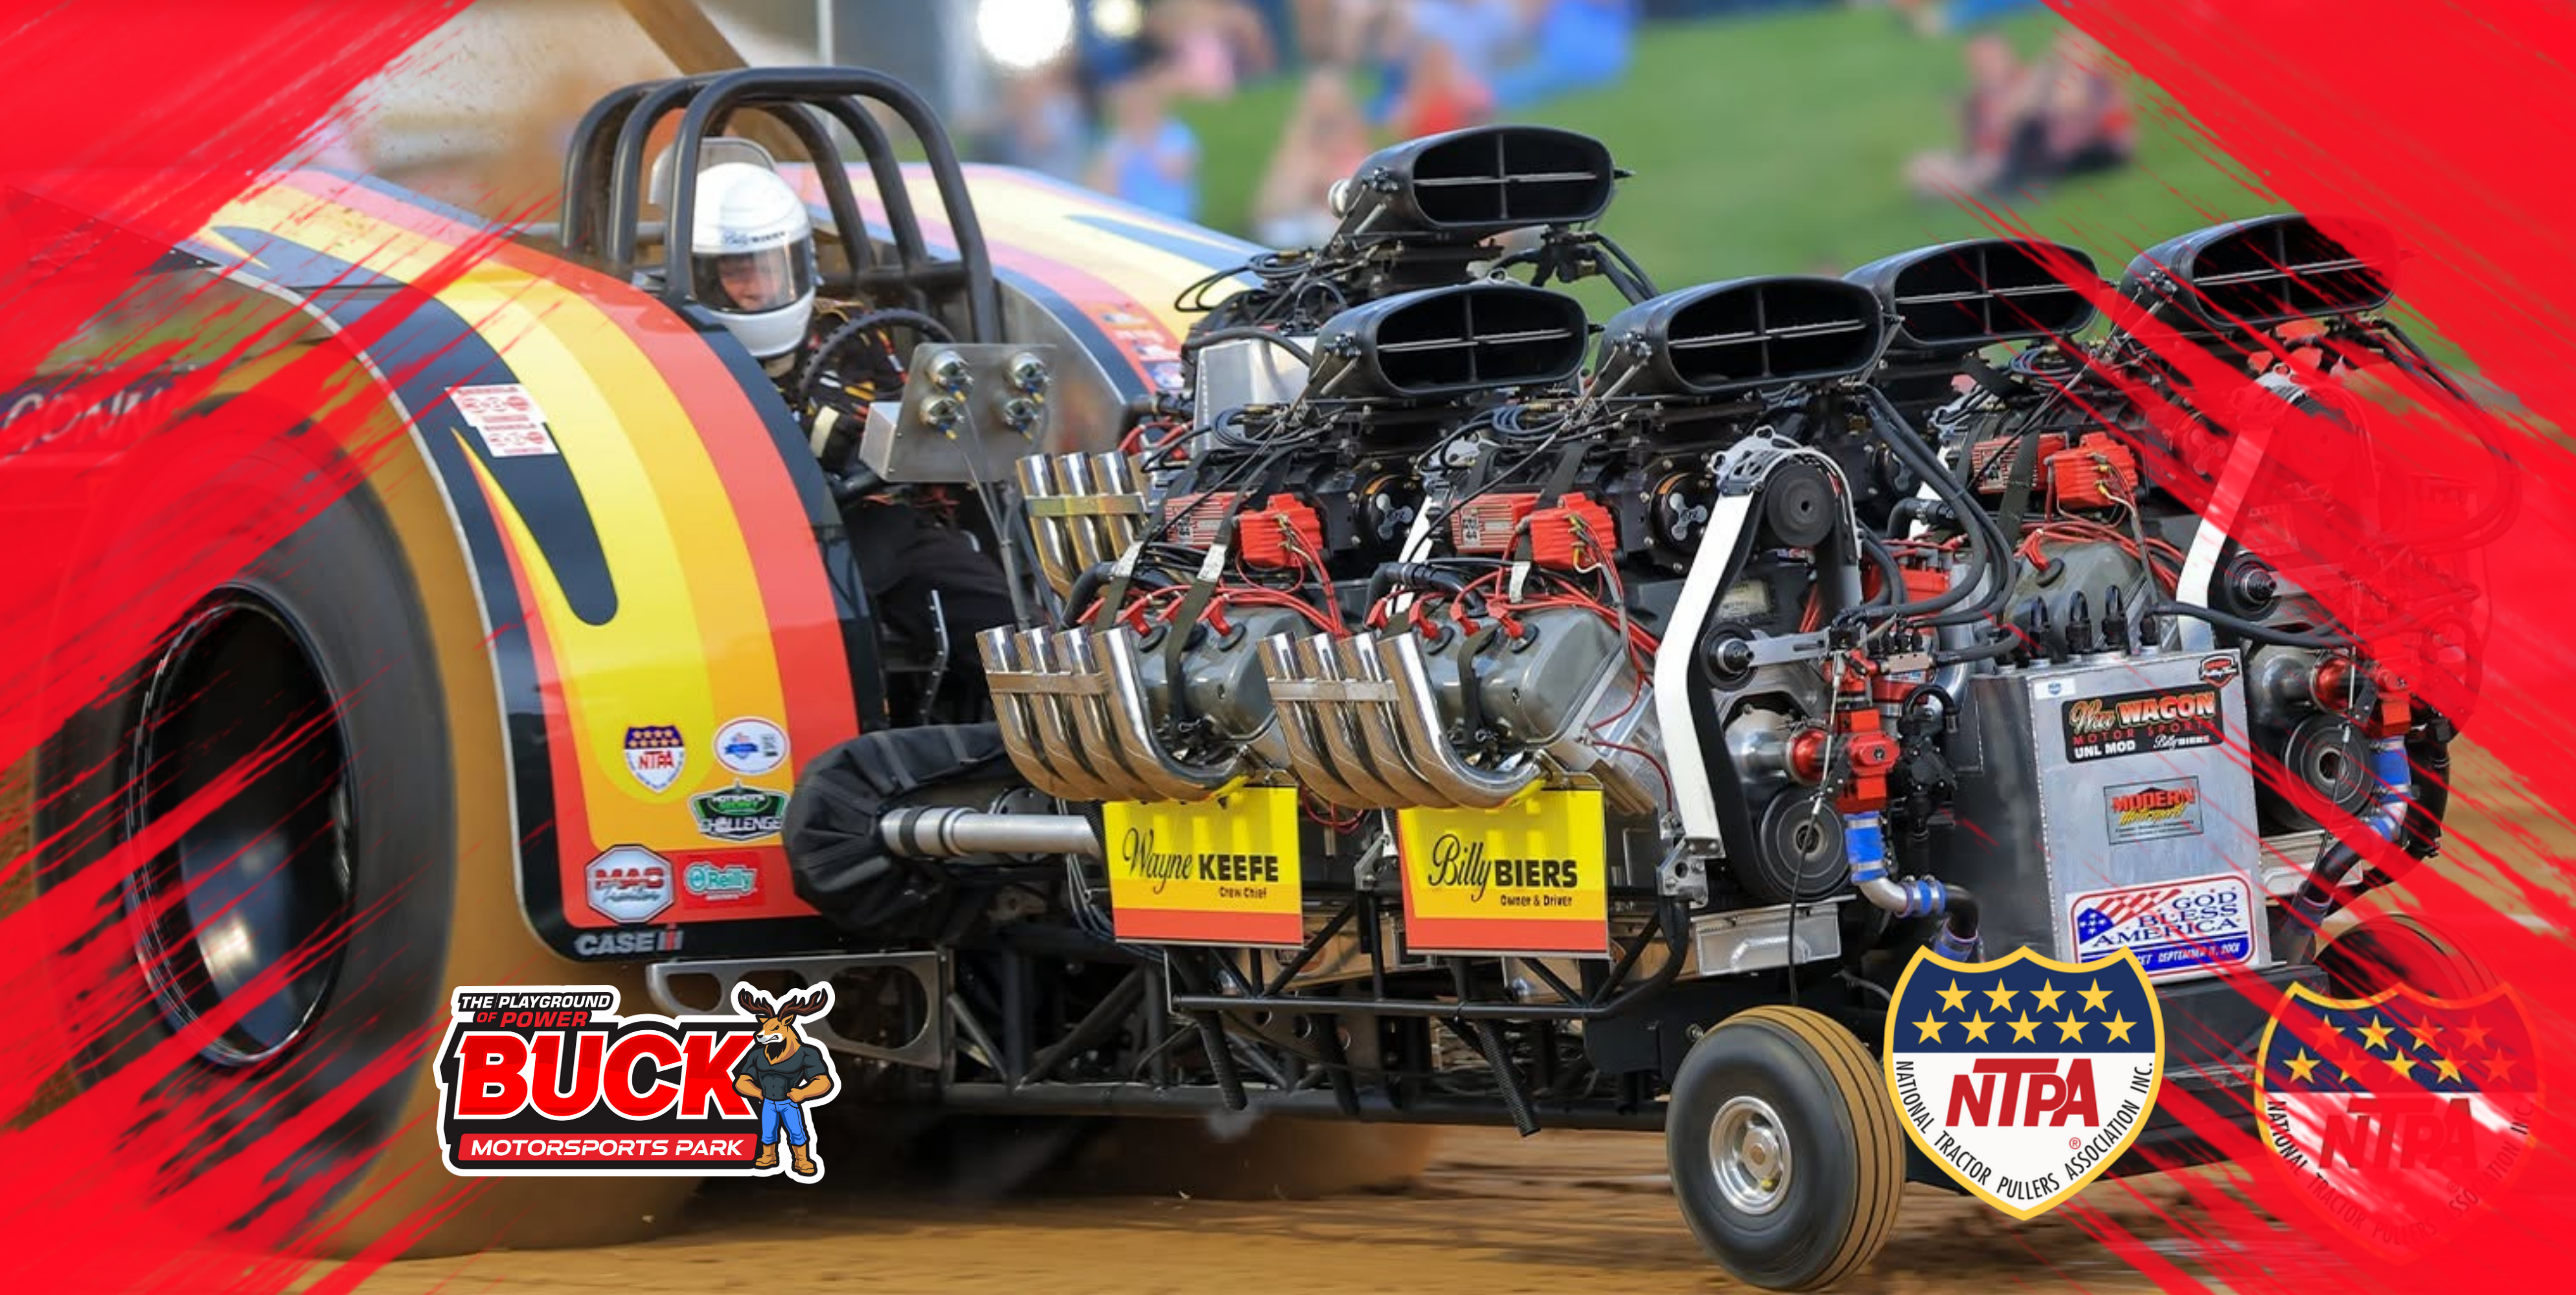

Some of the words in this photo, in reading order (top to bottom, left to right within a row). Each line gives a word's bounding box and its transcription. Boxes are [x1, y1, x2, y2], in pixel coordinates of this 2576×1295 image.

[2117, 692, 2216, 728] WAGON
[2073, 728, 2134, 745] MOTOR
[638, 750, 674, 770] NTPA
[2075, 745, 2102, 759] UNL
[2104, 740, 2136, 754] MOD
[2112, 787, 2196, 813] MODERN
[1122, 826, 1193, 895] Wayne
[1198, 854, 1279, 882] KEEFE
[1428, 833, 1491, 903] Billy
[1495, 859, 1578, 888] BIERS
[1219, 886, 1242, 899] Crew
[1244, 886, 1267, 899] Chief
[1501, 894, 1531, 906] Owner
[1533, 895, 1540, 906] &
[1544, 894, 1573, 906] Driver
[2171, 891, 2238, 910] GOD
[2139, 903, 2239, 927] BLESS
[574, 930, 654, 956] CASE
[2092, 918, 2239, 948] AMERICA
